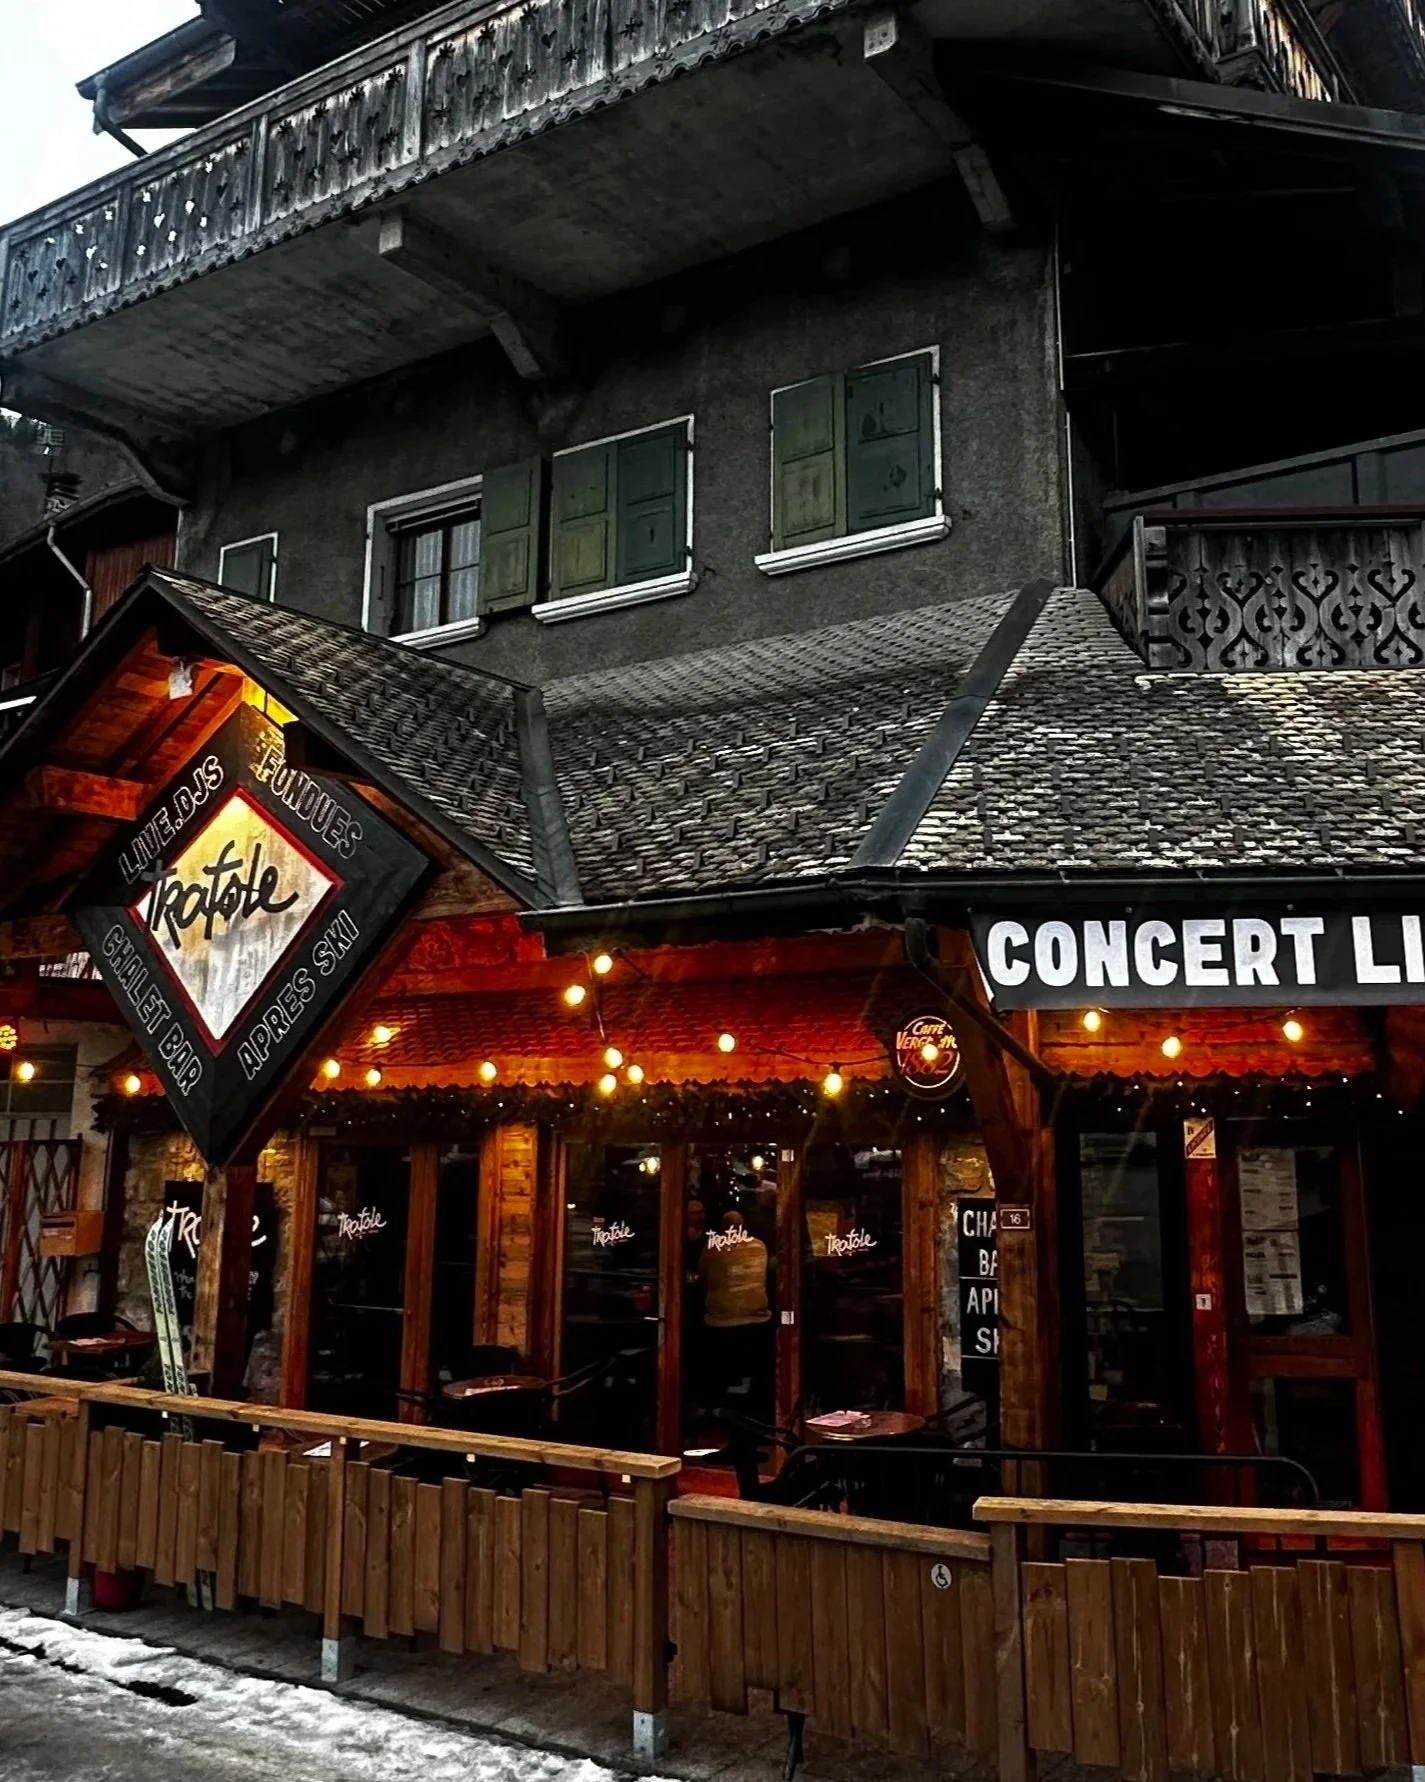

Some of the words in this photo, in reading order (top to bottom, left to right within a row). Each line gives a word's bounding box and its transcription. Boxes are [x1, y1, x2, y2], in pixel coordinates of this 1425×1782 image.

[101, 924, 171, 1035] CHALET
[158, 1022, 203, 1096] BAR
[238, 968, 317, 1080] APRES
[312, 909, 360, 976] SKI
[986, 917, 1325, 987] CONCERT
[1010, 1213, 1021, 1225] 16
